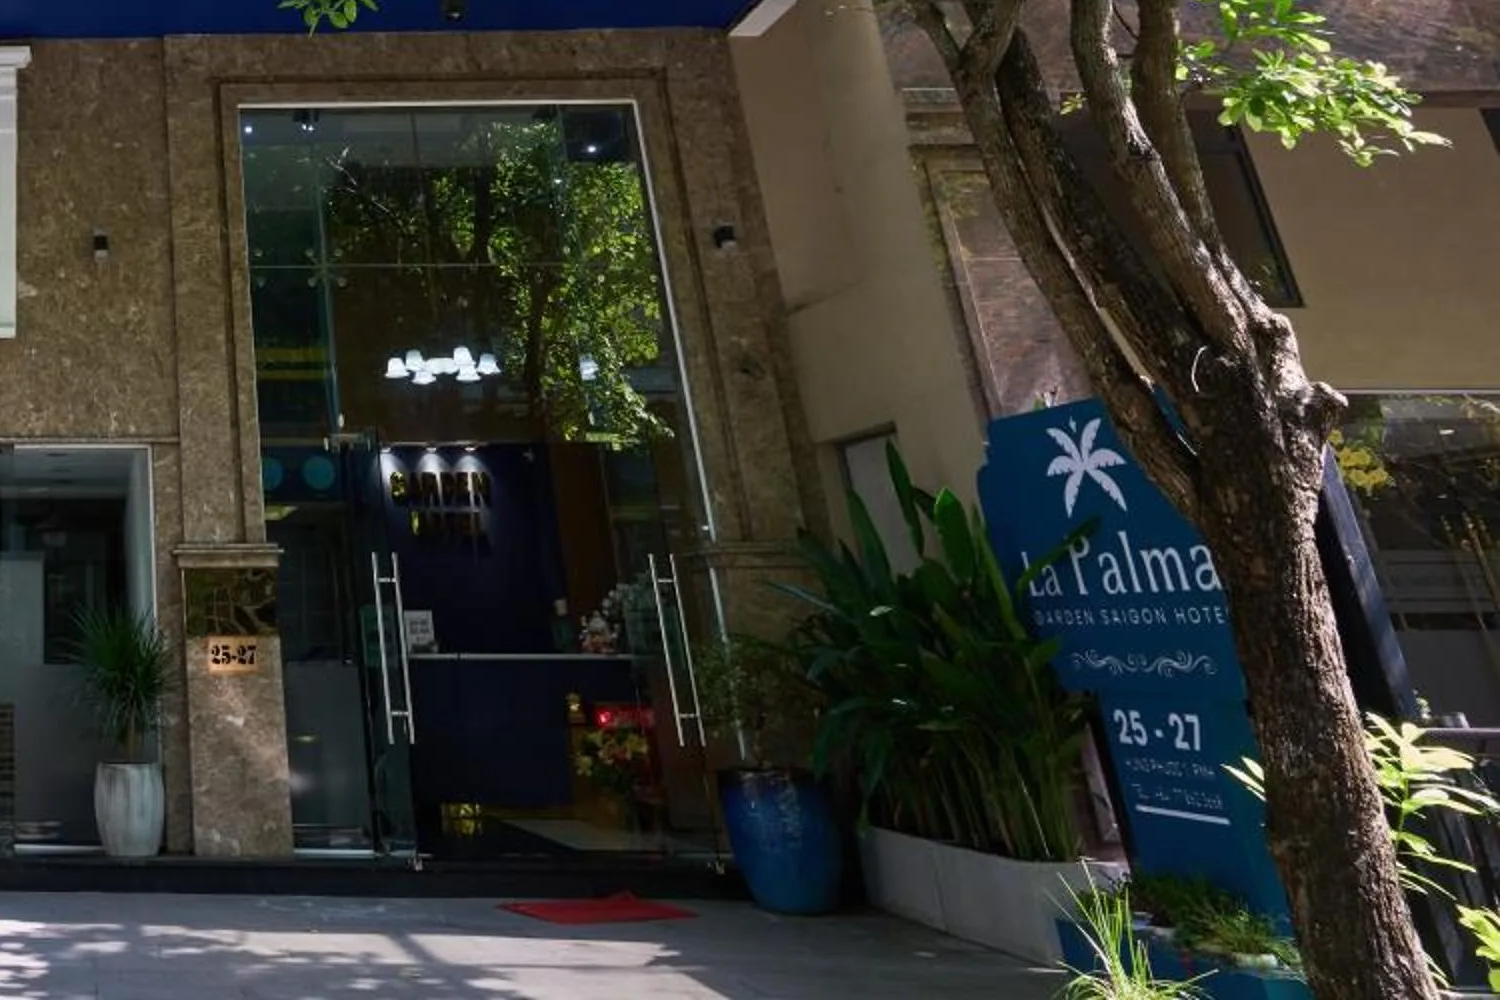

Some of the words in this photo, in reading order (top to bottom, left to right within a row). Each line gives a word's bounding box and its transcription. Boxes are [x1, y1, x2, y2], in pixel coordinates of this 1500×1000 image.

[1021, 551, 1063, 598] La
[1066, 530, 1223, 596] Palma
[1034, 608, 1095, 626] GARDEN
[1099, 608, 1168, 626] SAIGON
[1174, 606, 1230, 625] HOTE
[211, 645, 257, 665] 25-27
[1113, 708, 1148, 746] 25
[1169, 712, 1201, 752] 27
